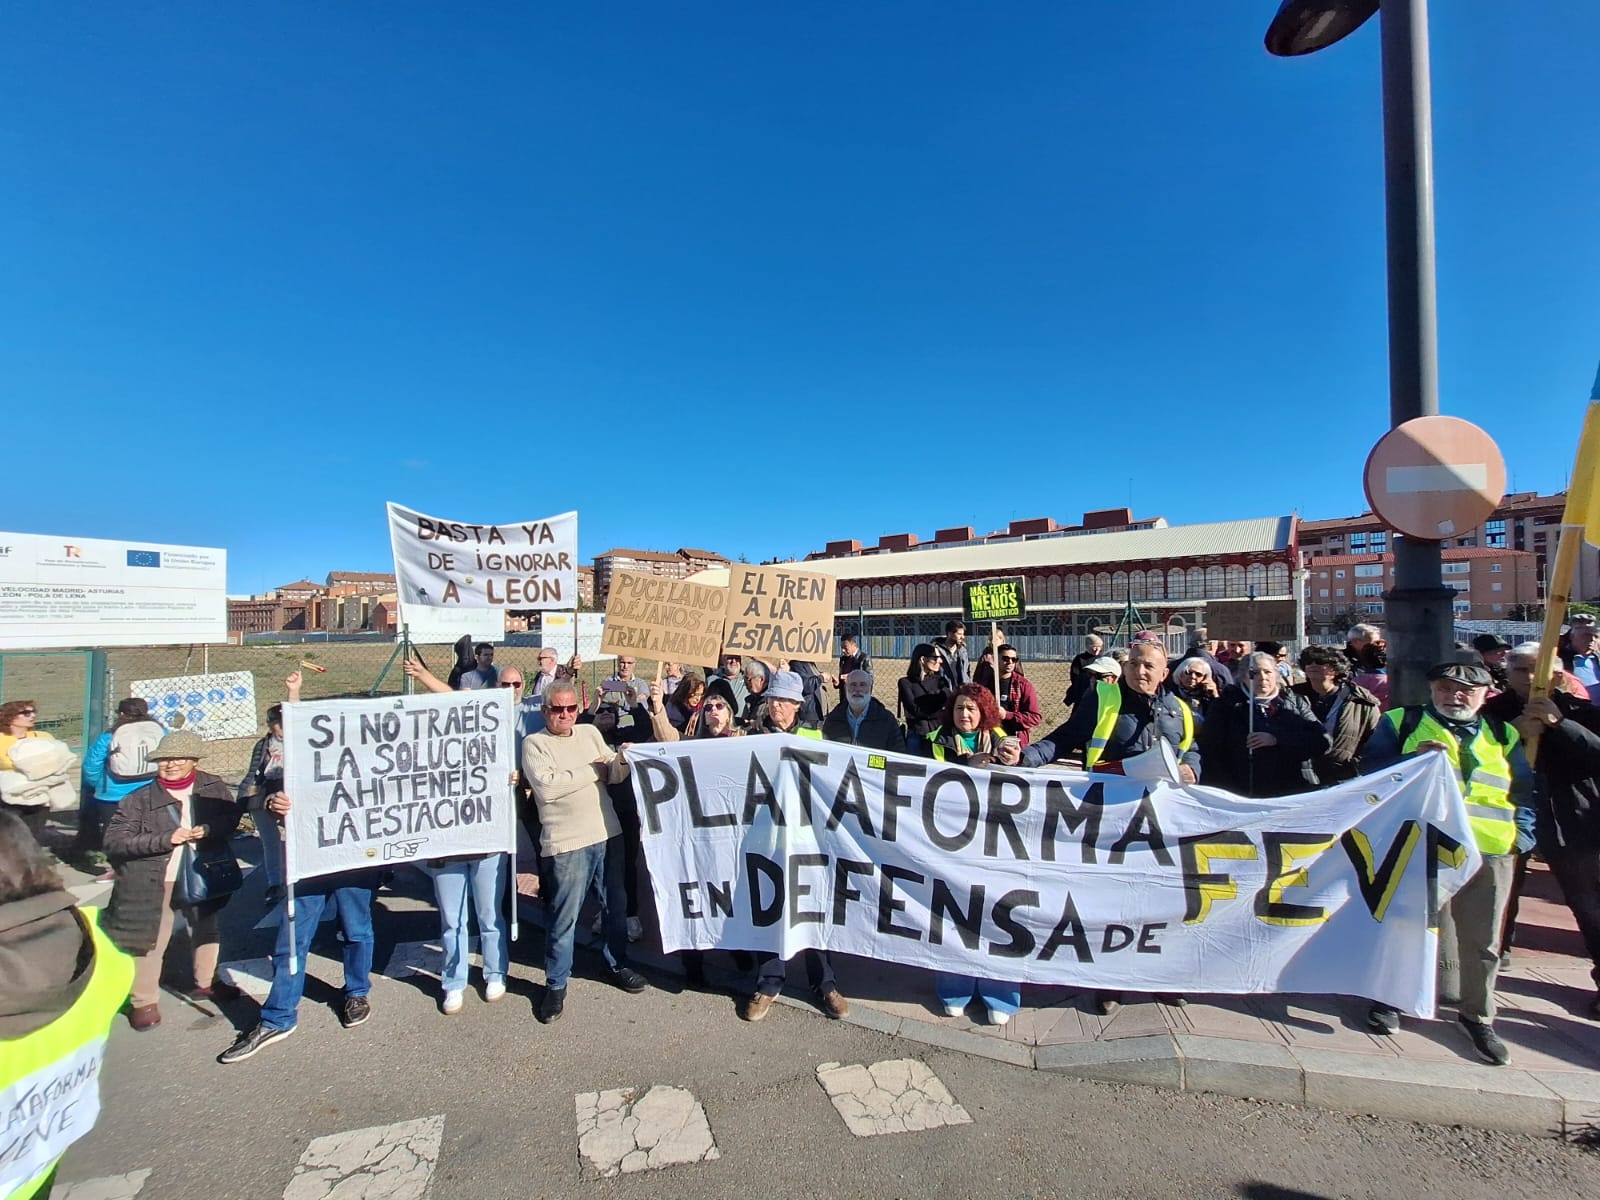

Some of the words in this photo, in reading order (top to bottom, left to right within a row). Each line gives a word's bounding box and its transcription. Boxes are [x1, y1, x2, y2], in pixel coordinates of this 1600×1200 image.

[417, 517, 506, 545] BASTA
[522, 522, 555, 546] YA
[428, 552, 455, 571] DE
[442, 580, 461, 604] A
[486, 574, 562, 605] LEÓN
[615, 573, 724, 612] PUCELANO
[741, 572, 767, 596] EL
[776, 573, 827, 602] TREN
[971, 592, 1018, 611] MENOS
[988, 583, 1009, 594] FEVE
[1009, 582, 1017, 593] Y
[608, 598, 704, 630] DÉJANOS
[705, 620, 722, 635] EL
[743, 597, 760, 617] A
[769, 598, 794, 621] LA
[607, 625, 651, 649] TREN
[650, 638, 660, 651] A
[660, 631, 717, 658] MANO
[360, 711, 401, 744] NO
[314, 747, 361, 783] LA
[634, 746, 1176, 867] PLATAFORMA
[317, 812, 360, 848] LA
[678, 880, 734, 920] EN
[746, 852, 1095, 964] DEFENSA
[1101, 902, 1168, 954] DE
